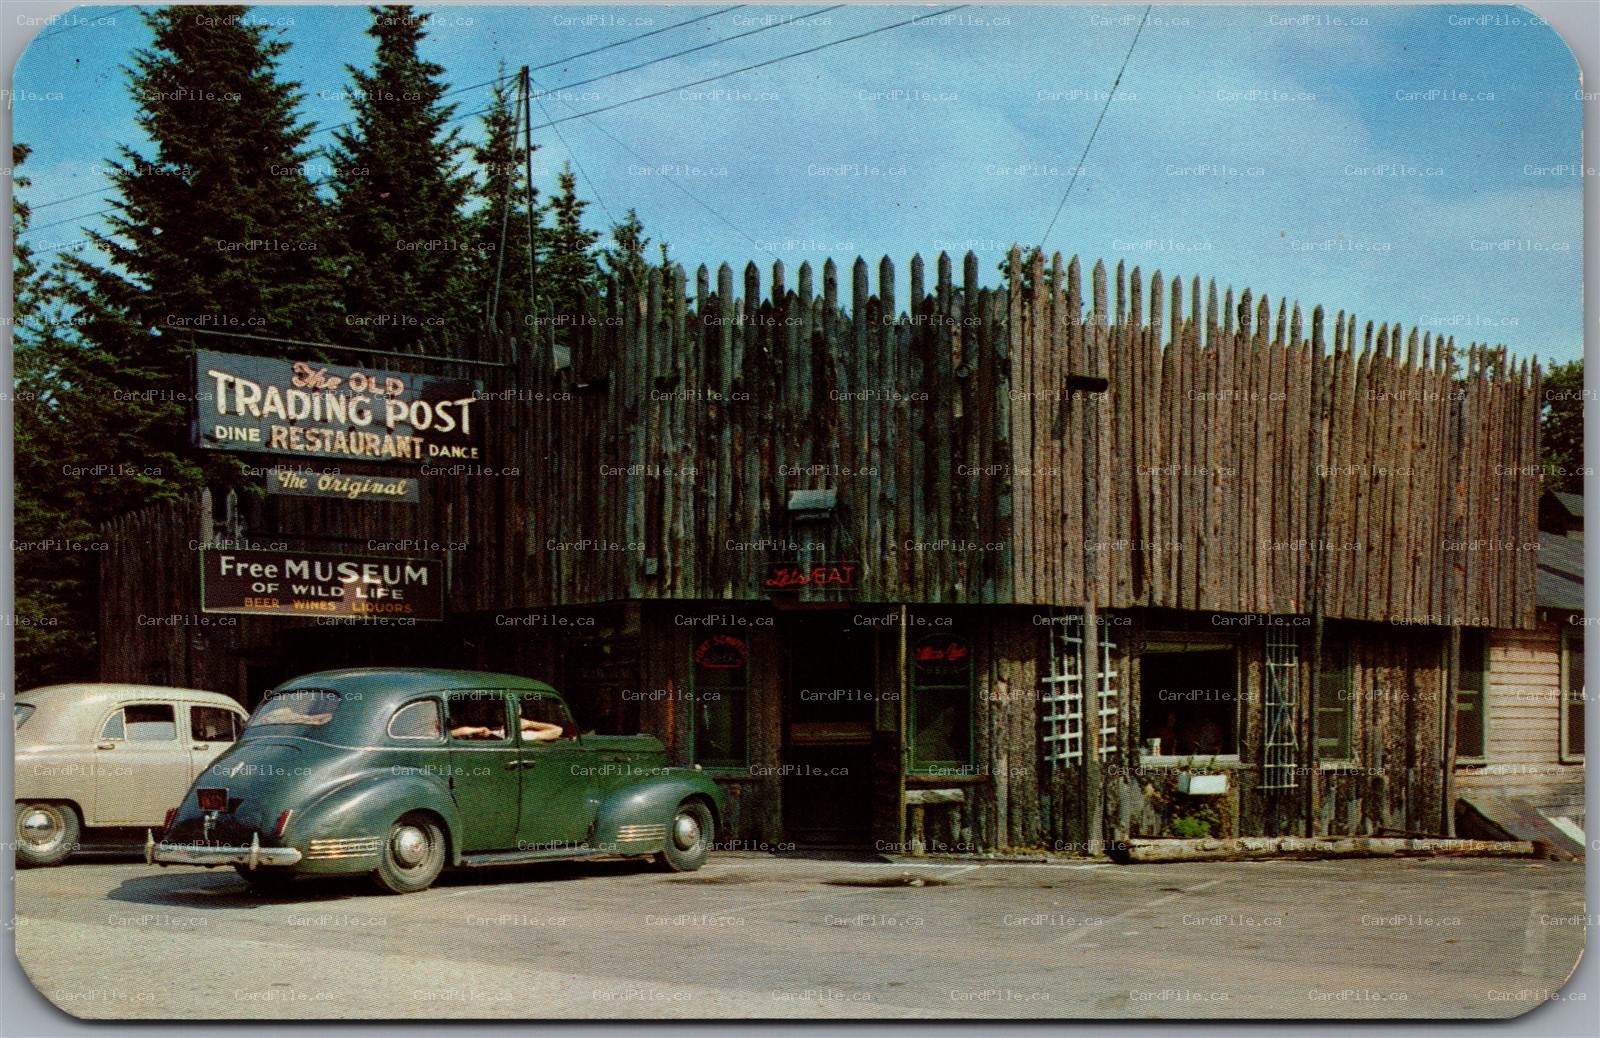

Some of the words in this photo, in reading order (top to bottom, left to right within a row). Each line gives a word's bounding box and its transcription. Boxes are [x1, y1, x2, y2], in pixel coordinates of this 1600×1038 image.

[292, 361, 342, 391] The
[349, 371, 404, 396] OLD
[209, 370, 372, 426] TRADING
[384, 397, 477, 436] POST
[214, 425, 260, 442] DINE
[271, 425, 424, 458] RESTAURANT
[429, 443, 479, 460] DANCE
[278, 471, 307, 489] The
[317, 476, 407, 499] Original
[220, 555, 278, 578] Free
[285, 558, 429, 586] MUSEUM
[813, 567, 855, 586] EAT
[244, 597, 280, 609] BEER
[292, 600, 336, 611] WINES
[352, 602, 413, 614] LIQUORS
[251, 582, 279, 594] OF
[291, 584, 345, 597] WILD
[355, 586, 404, 600] LIFE
